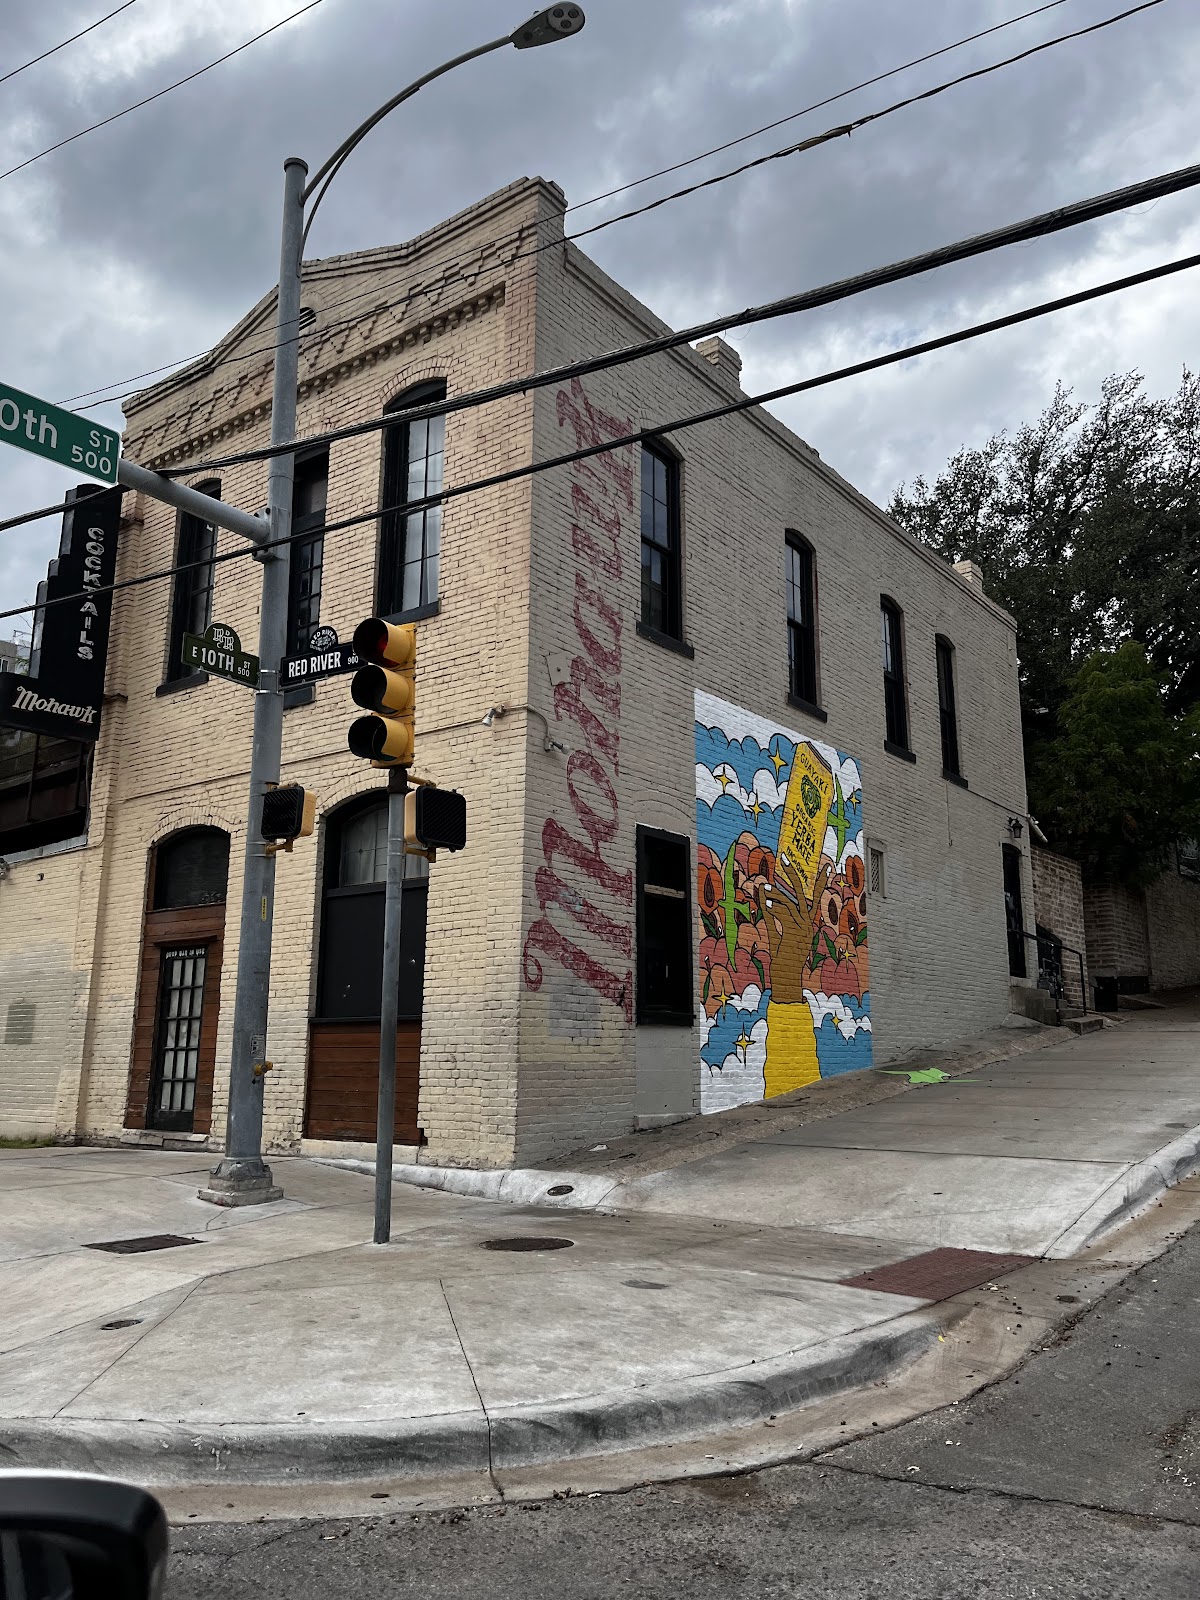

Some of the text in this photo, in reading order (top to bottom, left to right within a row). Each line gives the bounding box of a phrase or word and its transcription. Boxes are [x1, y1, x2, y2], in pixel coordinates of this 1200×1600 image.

[89, 430, 114, 452] ST
[71, 445, 112, 475] 500
[77, 527, 104, 660] COCKTAILS
[310, 631, 321, 645] RED
[192, 646, 251, 673] E 10TH ST
[237, 666, 250, 677] 500
[288, 651, 342, 678] RED RIVER
[12, 685, 98, 724] Mohawk
[523, 376, 633, 1025] Mohawk
[791, 810, 816, 854] YERBA
[792, 832, 811, 865] MATE
